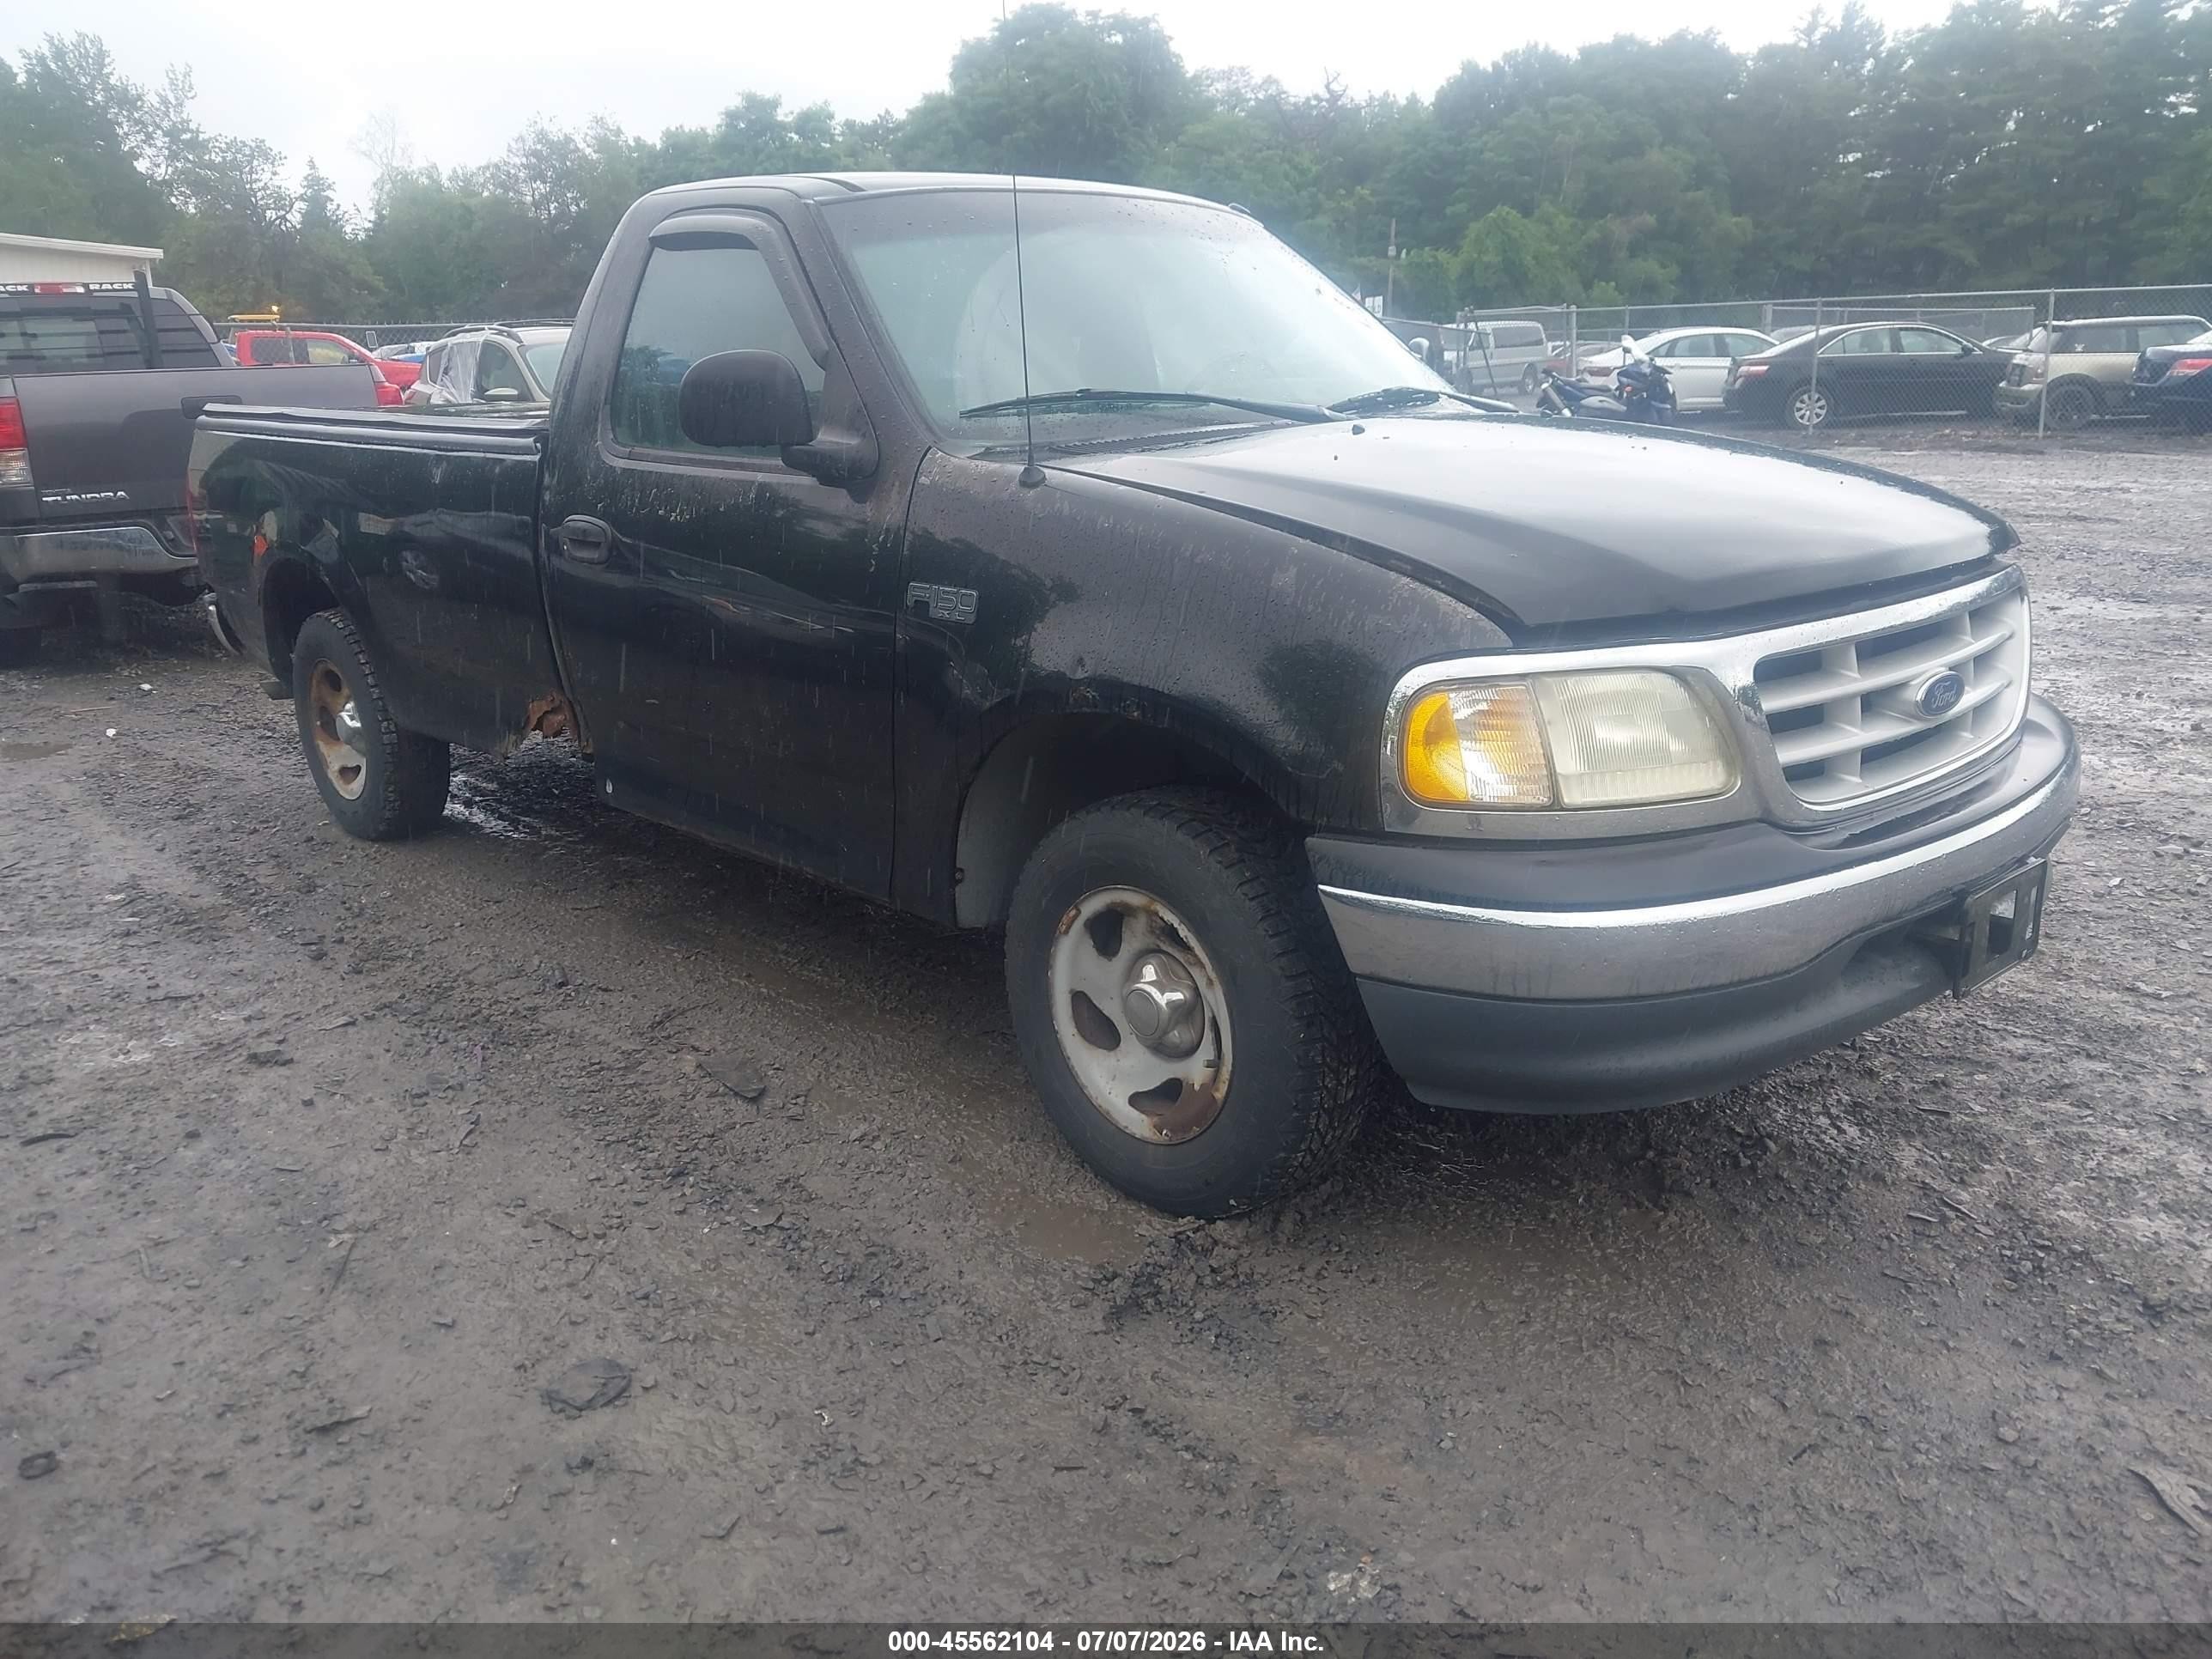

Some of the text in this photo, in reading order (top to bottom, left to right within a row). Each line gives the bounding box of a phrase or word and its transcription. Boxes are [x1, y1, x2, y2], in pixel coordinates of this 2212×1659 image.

[42, 490, 131, 504] TUNDRA
[938, 610, 965, 621] XL
[1930, 680, 1958, 708] Ford
